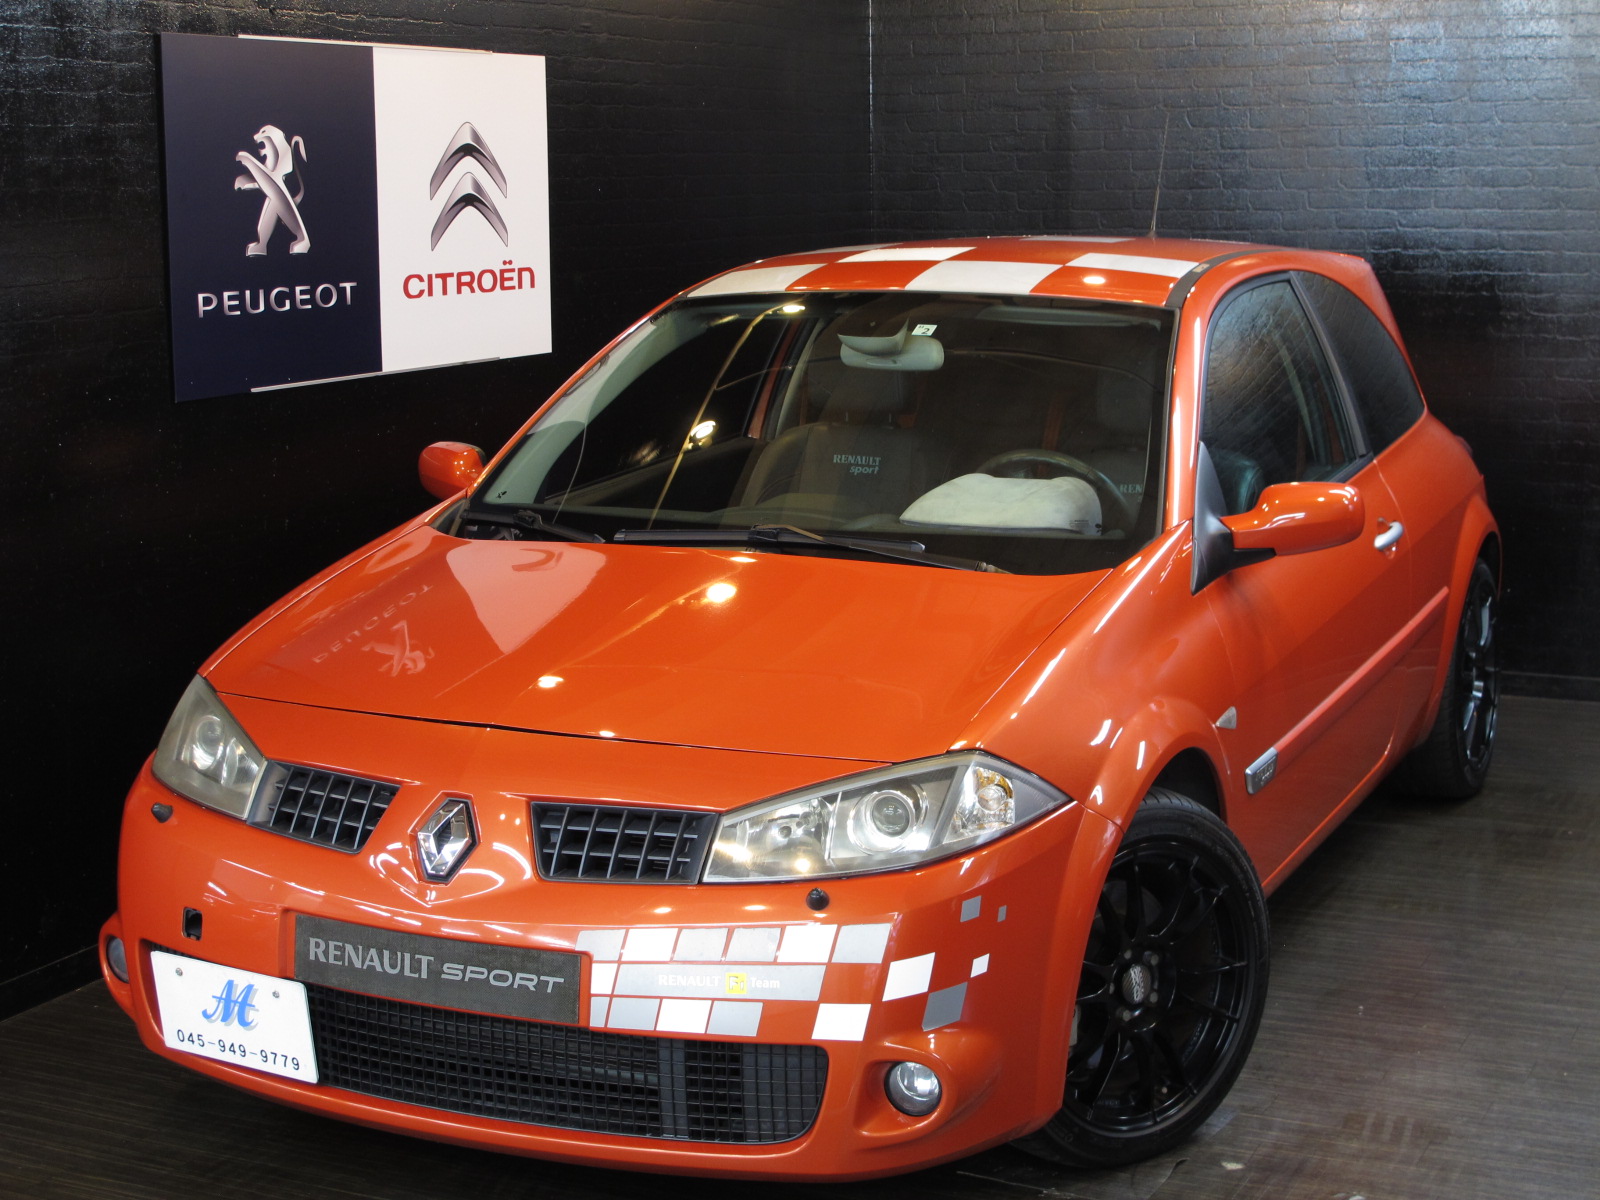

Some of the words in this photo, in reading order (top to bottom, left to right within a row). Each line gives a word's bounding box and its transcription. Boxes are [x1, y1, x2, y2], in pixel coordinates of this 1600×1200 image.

[198, 282, 357, 318] PEUGEOT
[833, 454, 881, 465] RENAULT
[849, 465, 880, 475] sport
[1120, 484, 1143, 493] REN
[308, 936, 435, 979] RENAULT
[441, 962, 565, 993] SPORT
[658, 974, 721, 987] RENAULT
[750, 977, 780, 989] Team
[177, 1029, 300, 1071] 045-949-9779
